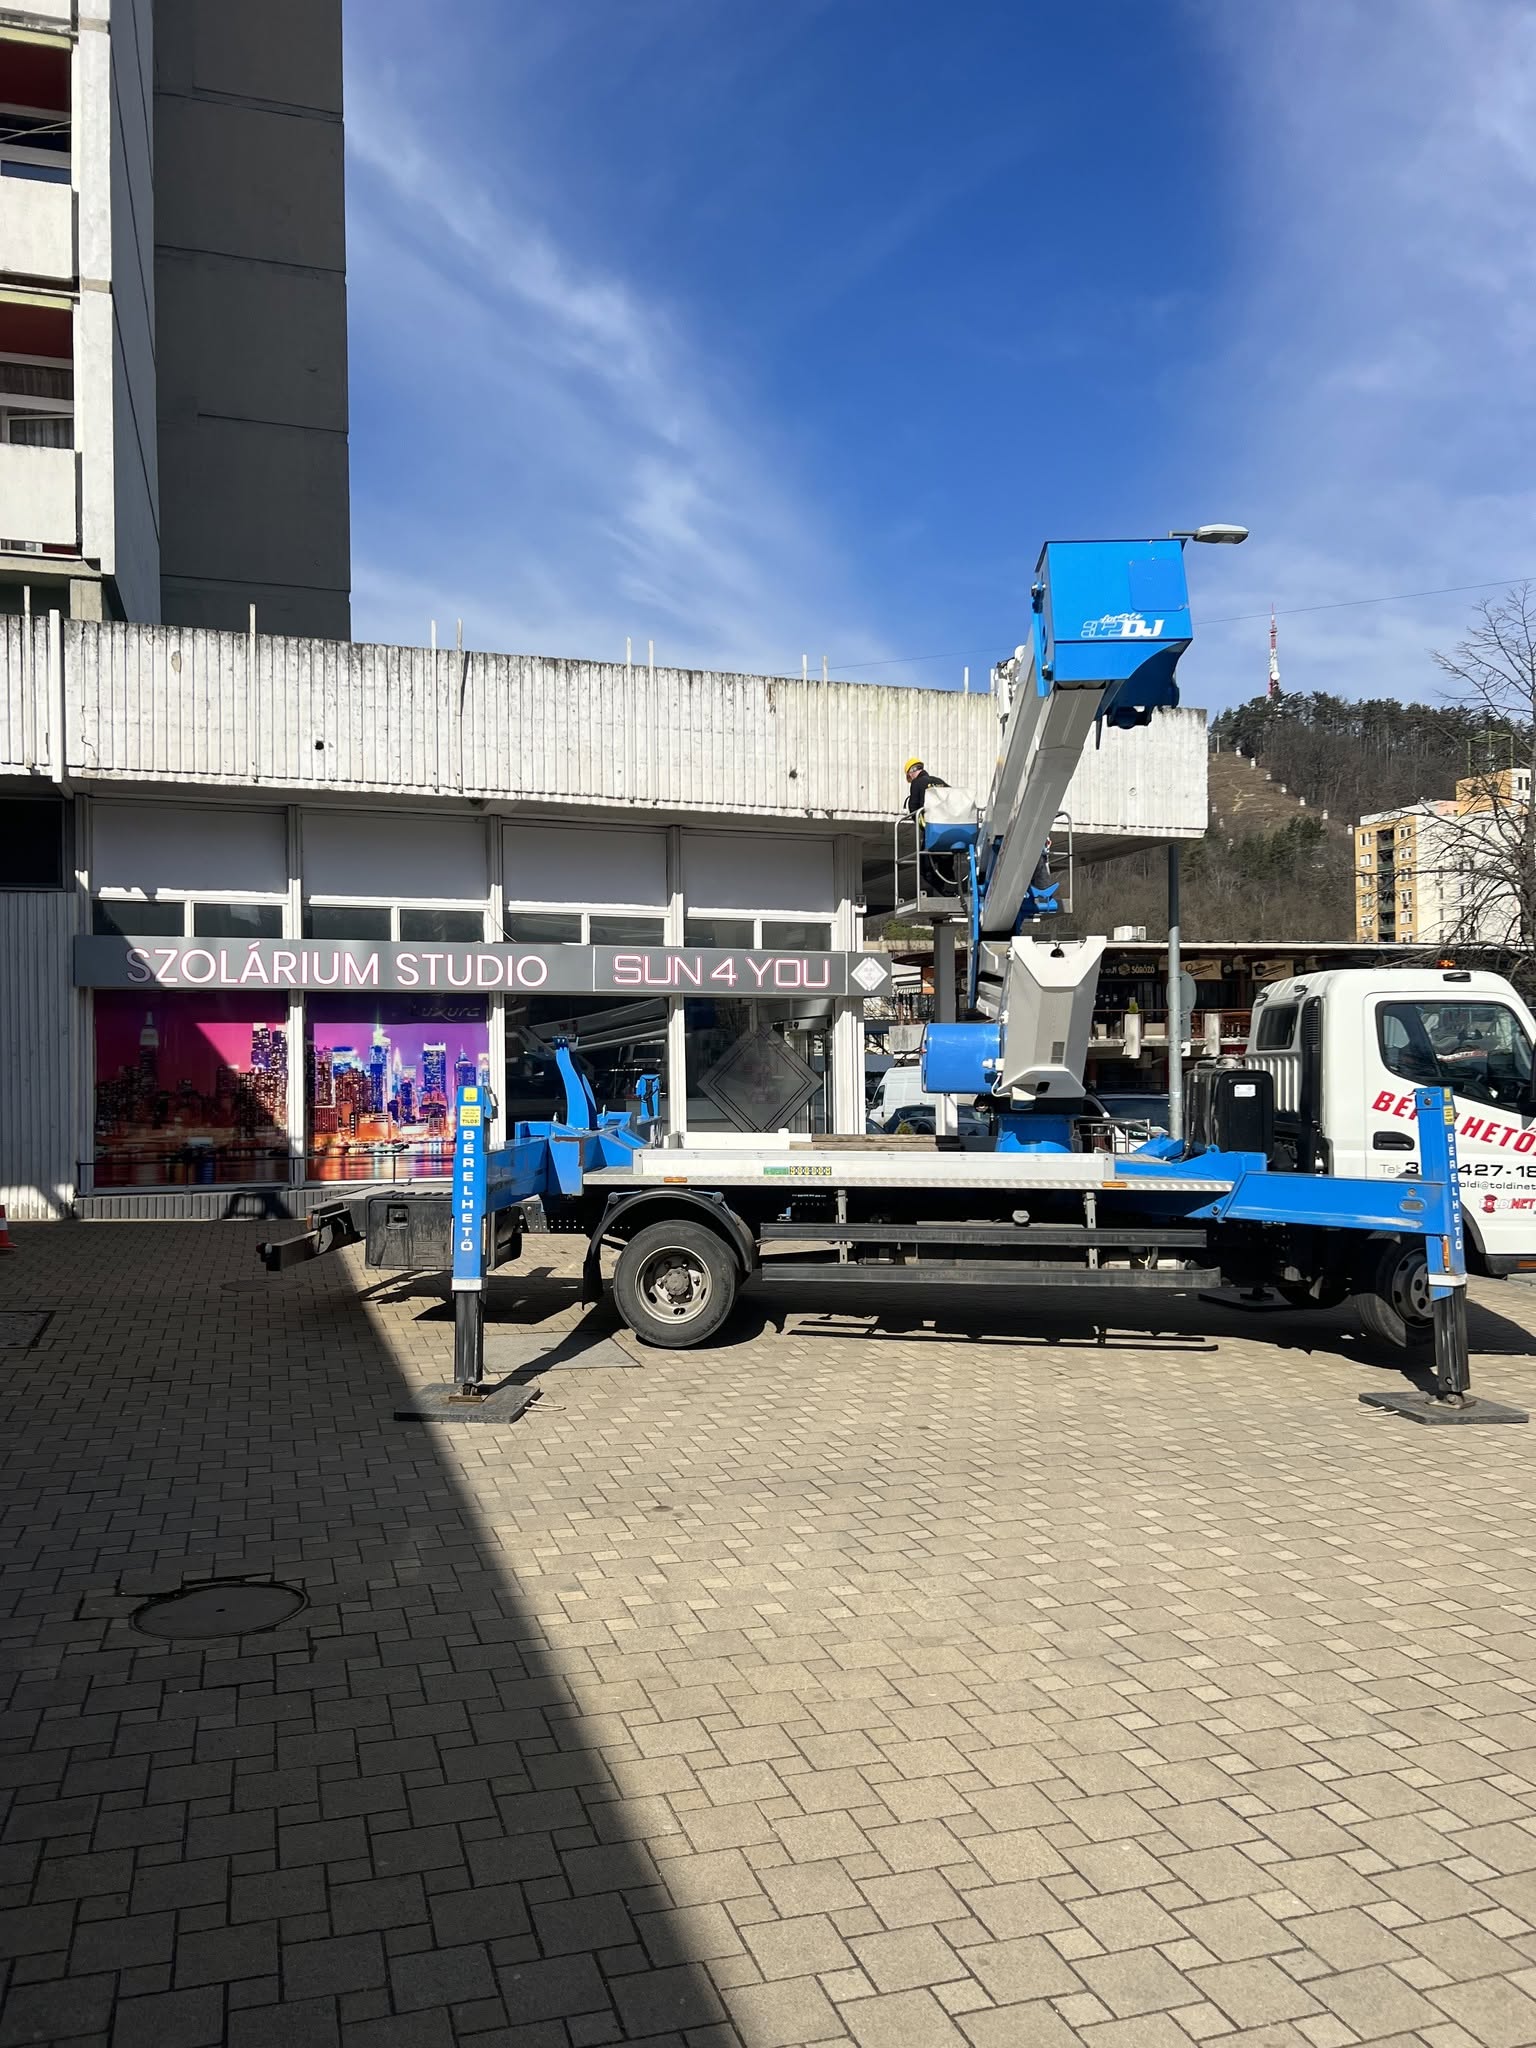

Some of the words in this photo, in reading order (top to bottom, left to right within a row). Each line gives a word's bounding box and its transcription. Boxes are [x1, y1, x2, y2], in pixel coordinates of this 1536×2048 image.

[125, 941, 379, 986] SZOLÁRIUM
[397, 951, 549, 987] STUDIO
[613, 954, 702, 986] SUN
[710, 957, 737, 987] 4
[745, 957, 830, 989] YOU
[460, 1130, 475, 1251] BÉRELHETŐ
[1459, 1181, 1536, 1190] oldi@toldinet
